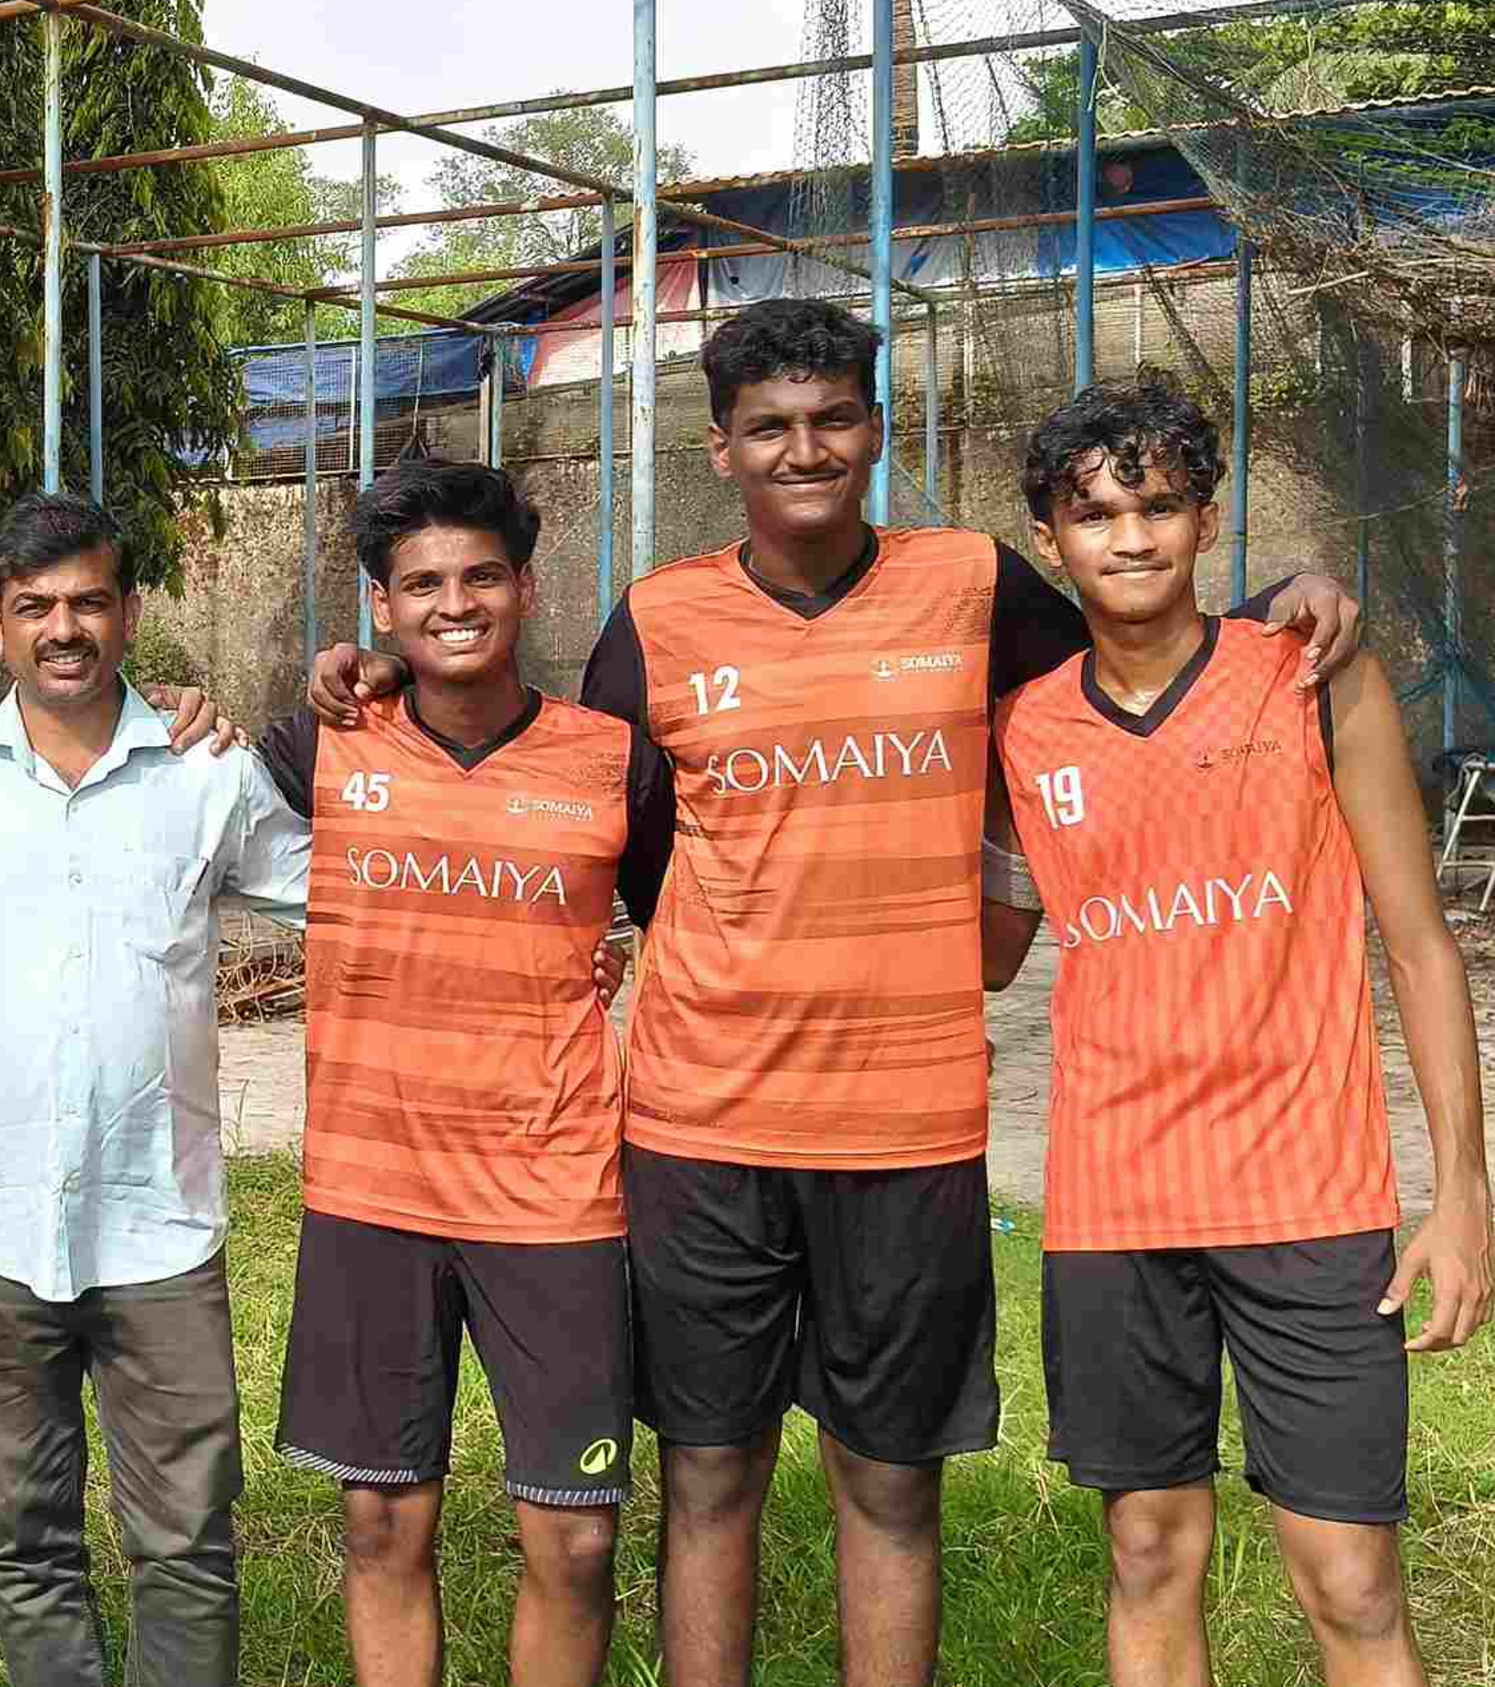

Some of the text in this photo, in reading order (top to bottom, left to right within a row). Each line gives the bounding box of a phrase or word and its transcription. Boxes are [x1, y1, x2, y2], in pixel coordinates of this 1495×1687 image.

[689, 666, 741, 715] 12
[342, 771, 391, 812] 45
[707, 730, 952, 794] SOMAIYA
[1036, 766, 1085, 829] 19
[346, 847, 566, 905] SOMAIYA
[1063, 871, 1294, 948] SOMAIYA
